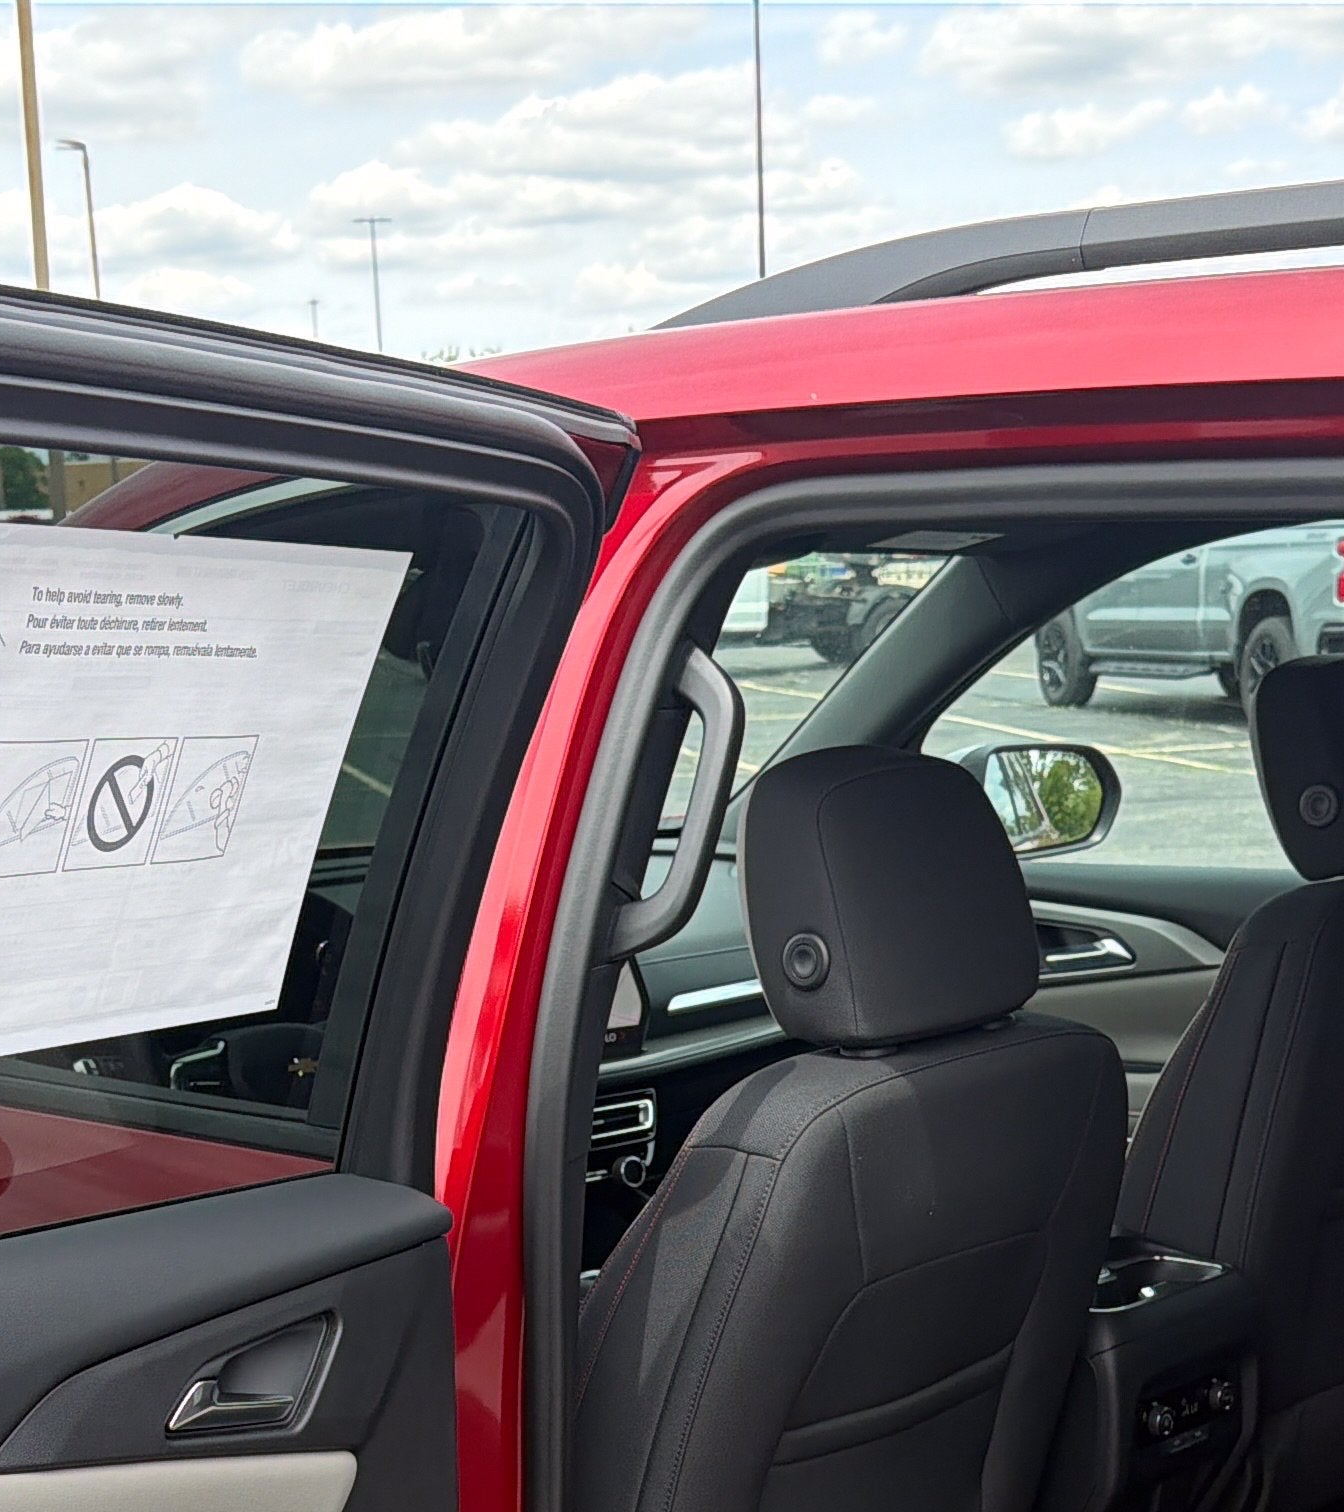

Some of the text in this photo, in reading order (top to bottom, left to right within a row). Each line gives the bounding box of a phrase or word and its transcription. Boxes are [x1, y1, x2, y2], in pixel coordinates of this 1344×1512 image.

[32, 586, 184, 609] To help avoid tearing, remove slowly.
[26, 613, 208, 632] Pour éviter toute déchirure, retirer lentement.
[19, 640, 41, 655] Para
[42, 641, 84, 658] ayudarse
[84, 644, 91, 656] a
[91, 642, 116, 656] evitar
[116, 644, 132, 658] que
[132, 645, 143, 656] se
[144, 644, 171, 658] rompa,
